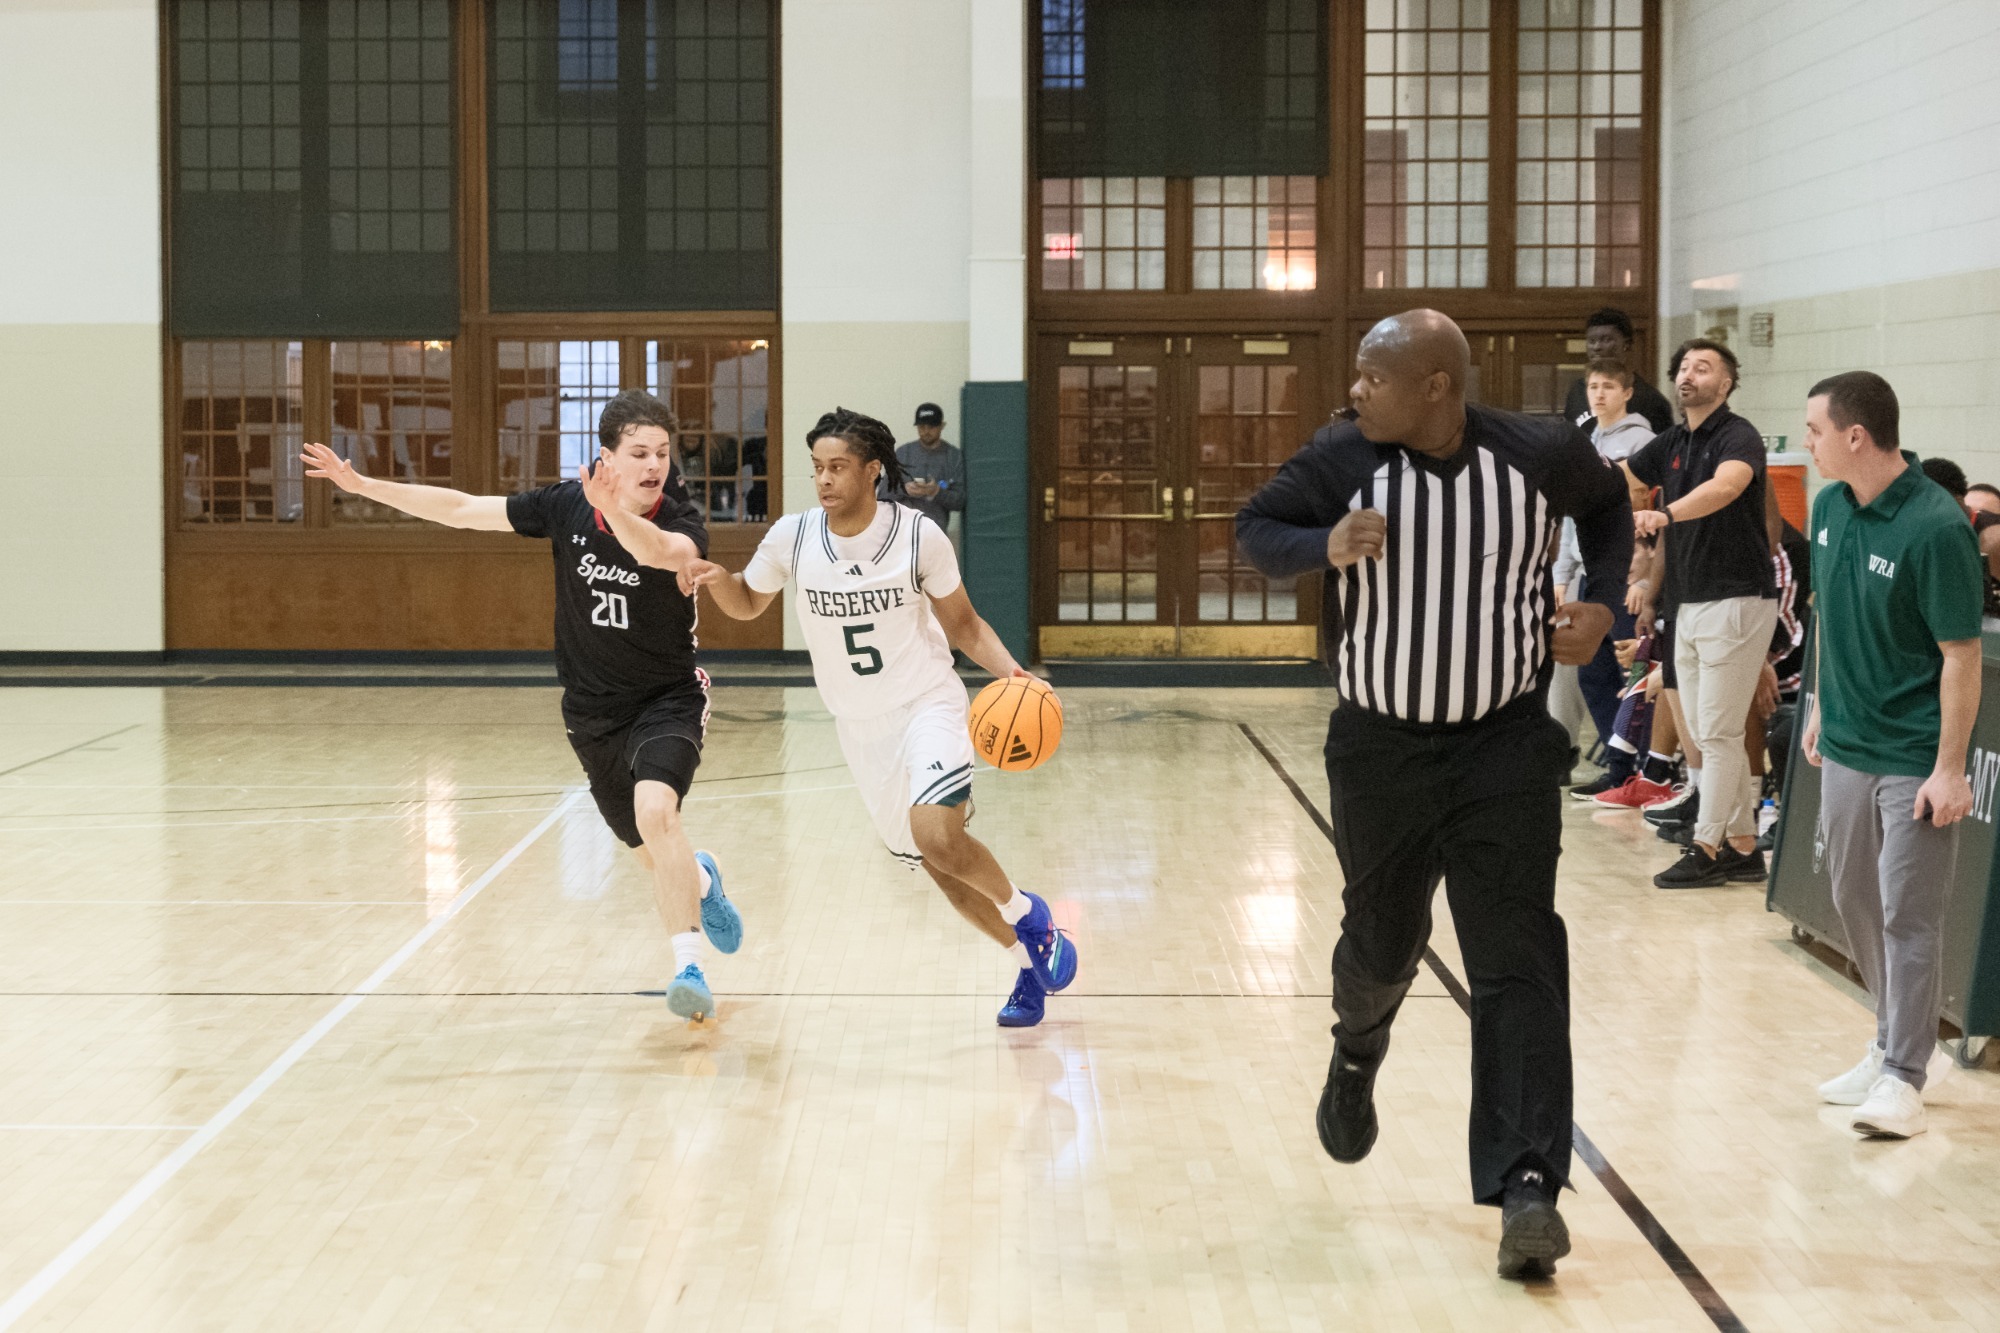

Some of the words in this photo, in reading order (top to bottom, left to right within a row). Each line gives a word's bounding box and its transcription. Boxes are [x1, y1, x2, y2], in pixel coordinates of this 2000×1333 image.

[577, 553, 640, 586] Spire
[1869, 554, 1895, 578] WRA
[592, 589, 628, 629] 20
[805, 587, 904, 617] RESERVE
[843, 623, 884, 676] 5
[984, 724, 1000, 755] PRO
